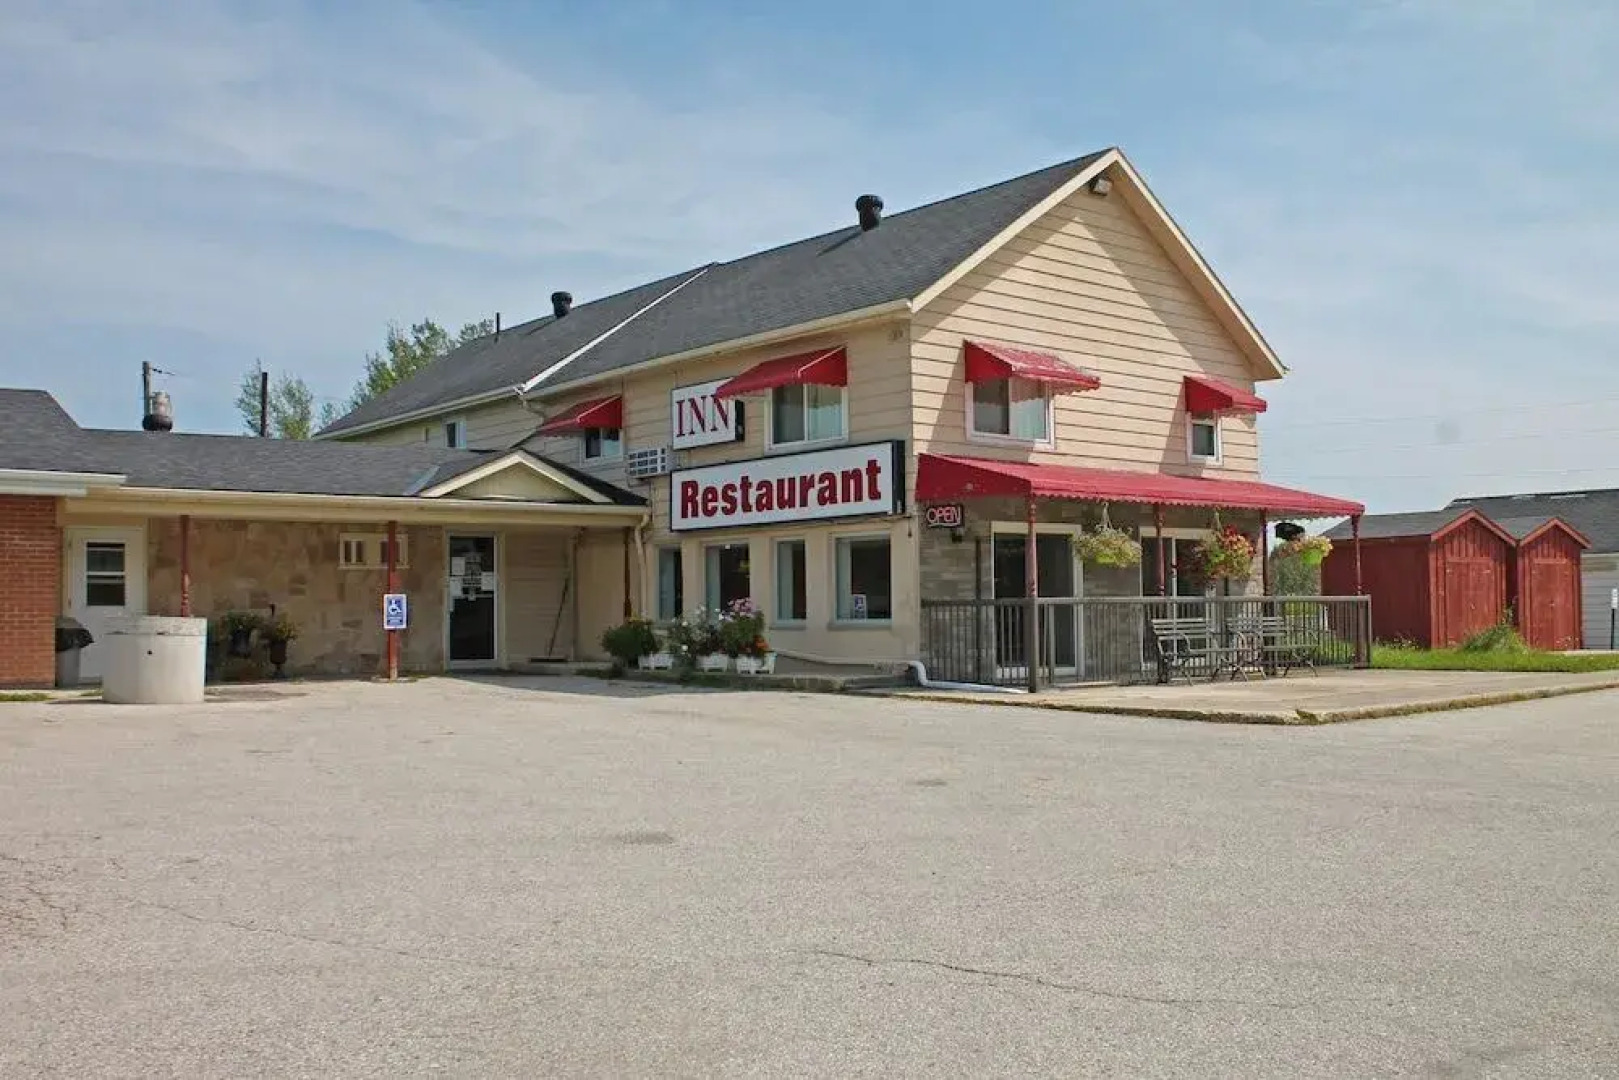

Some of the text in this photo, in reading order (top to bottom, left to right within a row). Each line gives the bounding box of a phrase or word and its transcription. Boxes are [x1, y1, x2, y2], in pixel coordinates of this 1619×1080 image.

[676, 394, 730, 438] INN
[681, 459, 882, 520] Restaurant
[925, 504, 961, 523] OPEN
